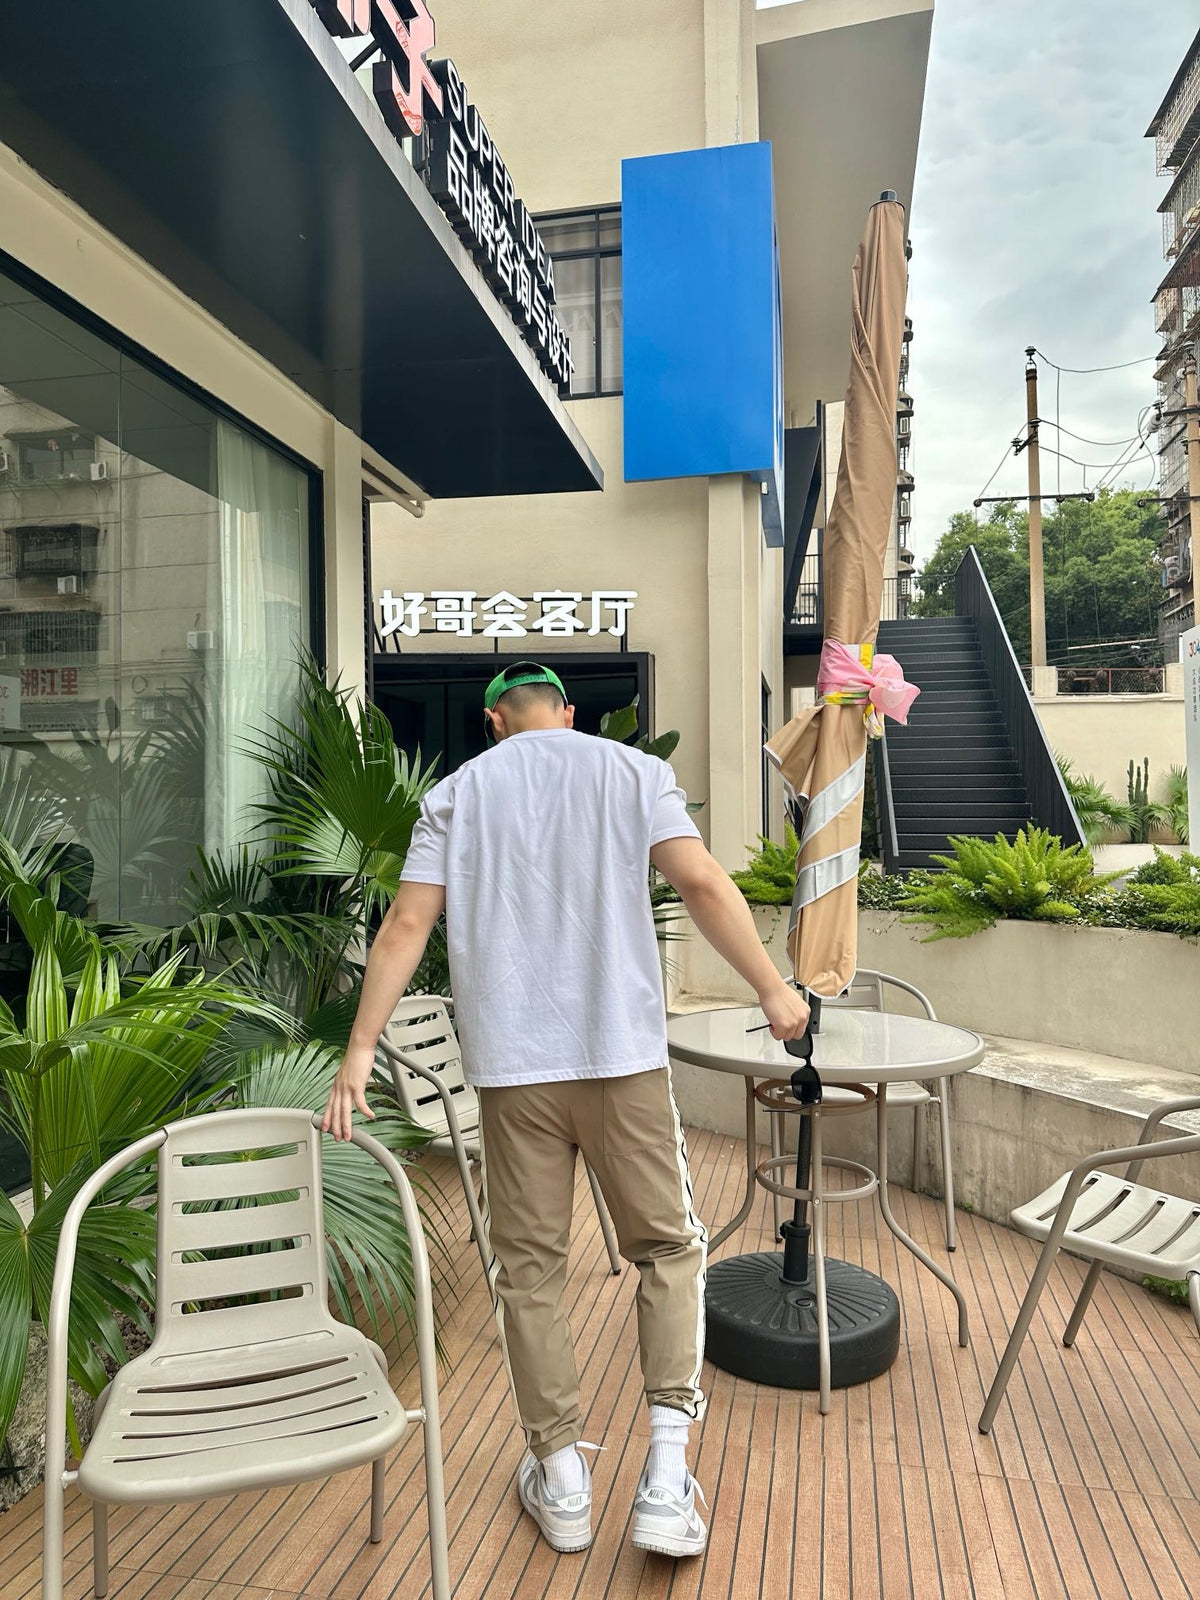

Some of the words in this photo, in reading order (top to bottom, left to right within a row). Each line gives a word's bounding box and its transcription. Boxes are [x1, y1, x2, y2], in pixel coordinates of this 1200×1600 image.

[447, 59, 517, 228] SUPER
[521, 202, 556, 302] IDEA
[447, 121, 575, 396] 品牌咨询与设计
[379, 589, 639, 637] 好哥会客厅
[567, 1495, 583, 1508] NIKE
[648, 1488, 665, 1499] NIKE
